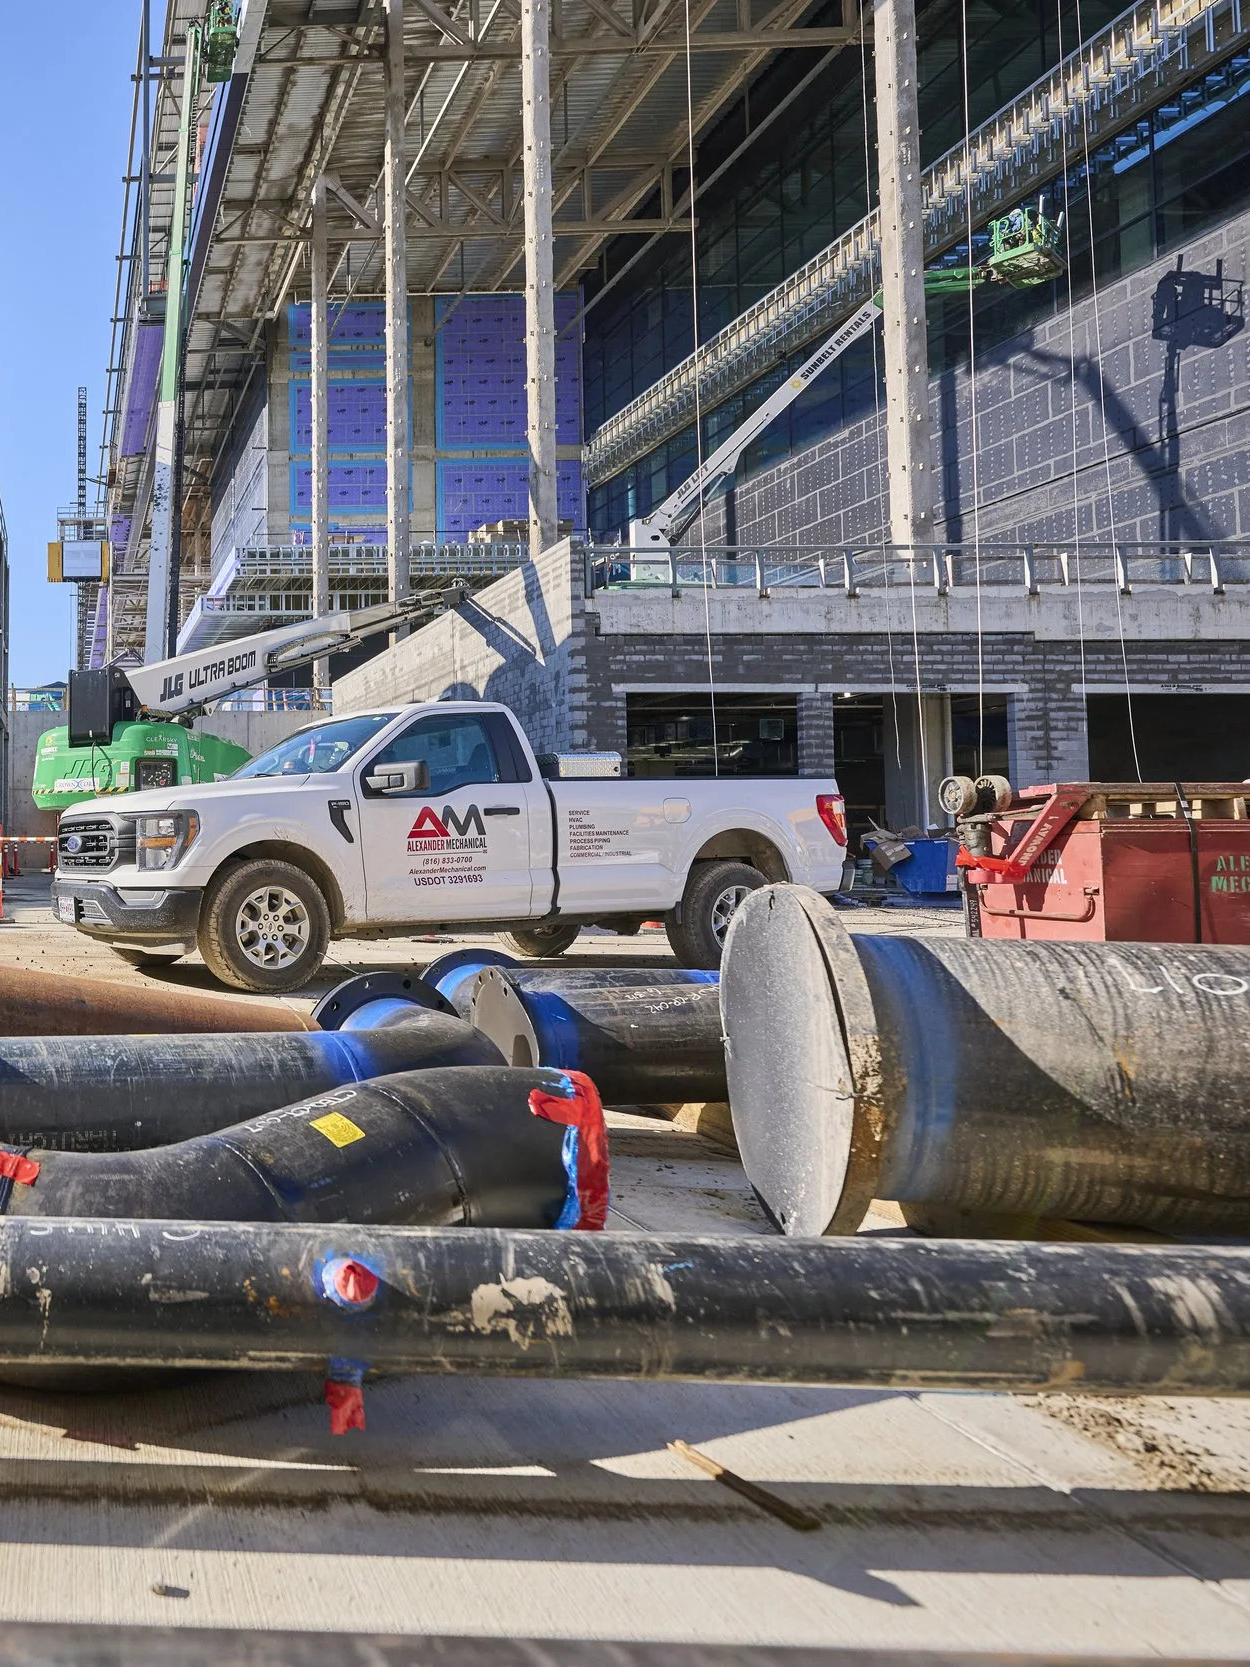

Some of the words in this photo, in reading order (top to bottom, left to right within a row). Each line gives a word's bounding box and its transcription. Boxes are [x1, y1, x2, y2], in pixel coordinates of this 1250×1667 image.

[800, 345, 837, 380] SUNBELT
[834, 311, 872, 347] RENTALS
[677, 481, 691, 500] JLG
[160, 673, 184, 703] JLG
[189, 660, 226, 690] ULTRA
[227, 650, 256, 676] BOOM
[407, 804, 486, 838] AM
[407, 839, 446, 852] ALEXANDER
[446, 837, 488, 850] MECHANICAL
[409, 865, 487, 875] AlexanderMechanical.com
[422, 857, 441, 867] (816)
[441, 856, 473, 865] 833-0700
[414, 876, 446, 887] USDOT
[448, 874, 484, 885] 3291693
